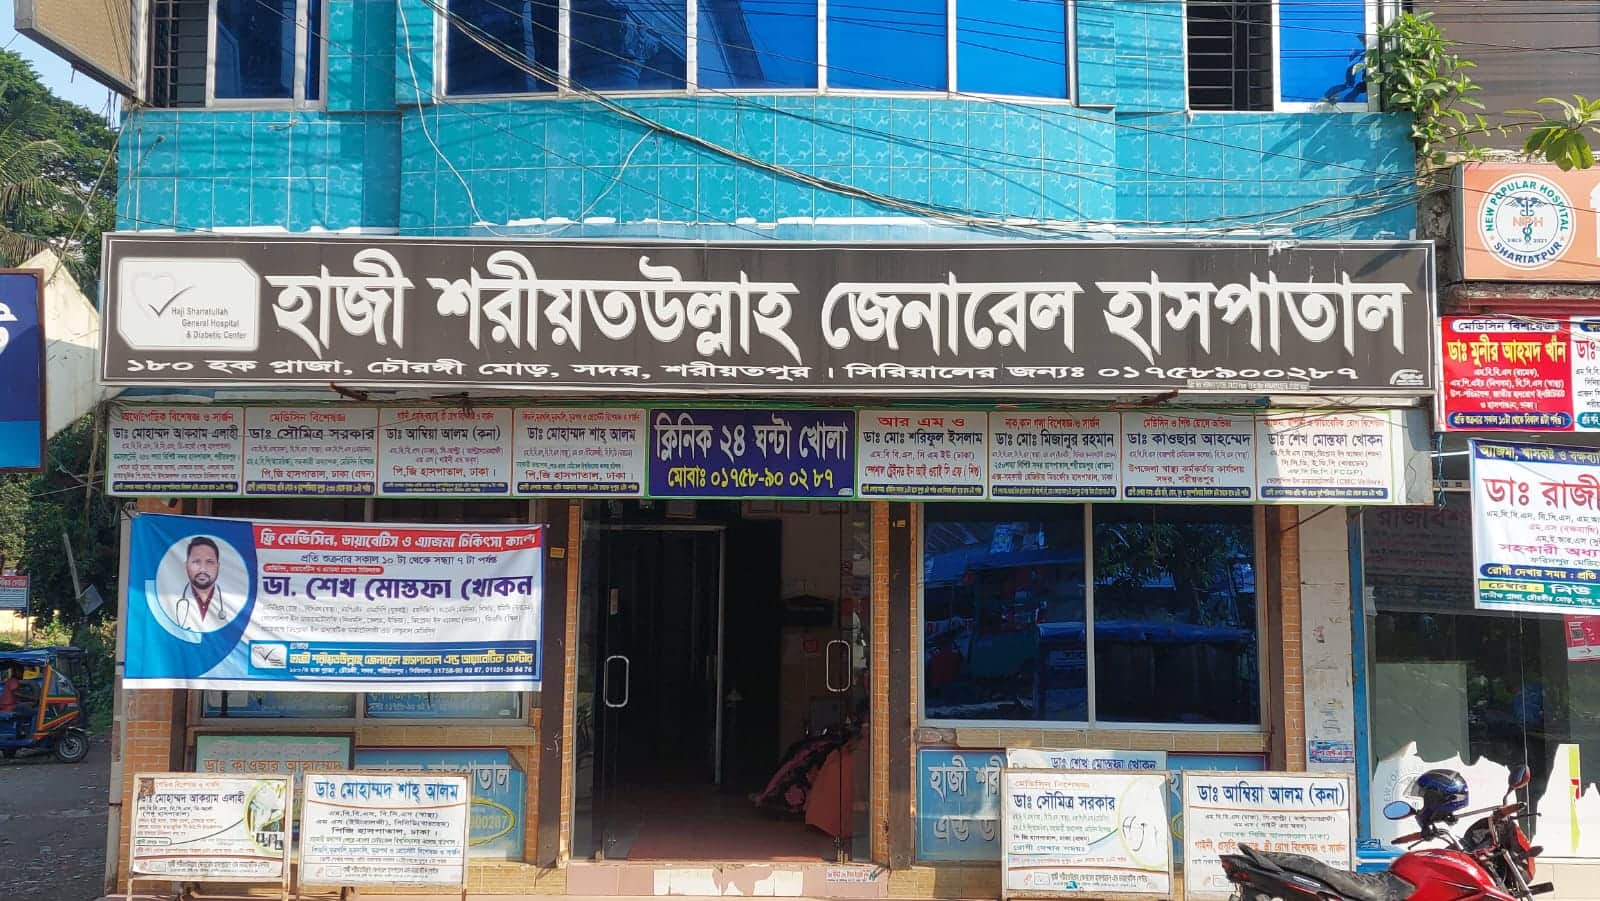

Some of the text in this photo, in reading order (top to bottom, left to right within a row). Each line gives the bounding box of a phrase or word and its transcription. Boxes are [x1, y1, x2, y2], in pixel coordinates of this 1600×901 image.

[1485, 181, 1570, 232] NEW POPULAR HOSPITAL
[1494, 242, 1564, 266] SHARIATPUR
[264, 248, 1413, 366] হাজী শরীয়তউল্লাহ জেনারেল হাসপাতাল
[182, 319, 240, 328] General Hospital
[1446, 339, 1467, 363] ডাঃ
[127, 361, 194, 373] ১৮০
[204, 360, 259, 375] হক
[478, 362, 560, 378] মোড়,
[569, 365, 651, 379] সদর,
[661, 361, 812, 381] শরীয়তপুর
[841, 363, 998, 379] সিরিয়ালের
[1005, 366, 1084, 379] জন্যঃ
[878, 416, 965, 427] আর এম ও
[248, 424, 376, 441] ডাঃ সৌমিত্র সরকার
[384, 427, 402, 441] ডাঃ
[440, 427, 469, 441] আলম
[527, 426, 544, 441] ডাঃ
[609, 427, 636, 442] আলম
[653, 412, 714, 461] ক্লিনিক
[719, 425, 746, 464] ২৪
[798, 420, 849, 462] খোলা
[862, 430, 881, 445] ডাঃ
[884, 430, 905, 445] মোঃ
[947, 429, 983, 447] ইসলাম
[994, 428, 1114, 450] ডাঃ মোঃ মিজানুর রহমান
[1126, 432, 1148, 446] ডাঃ
[1151, 432, 1197, 447] কাওছার
[1288, 432, 1308, 446] শেখ
[1351, 432, 1384, 447] খোকন
[1482, 473, 1530, 507] ডাঃ
[278, 529, 338, 550] মেডিসিন,
[402, 536, 412, 547] ও
[1498, 544, 1560, 555] সহকারী
[354, 554, 380, 565] সকাল
[306, 577, 357, 601] শেখ
[364, 578, 452, 602] মোস্তফা
[460, 575, 534, 601] খোকন
[928, 755, 970, 804] হাজী
[314, 780, 336, 799] ডাঃ
[340, 780, 394, 801] মোহাম্মদ
[424, 781, 460, 802] আলম
[1013, 790, 1116, 811] ডাঃ সৌমিত্র সরকার
[1196, 784, 1218, 803] ডাঃ
[1268, 783, 1304, 804] আলম
[1309, 782, 1345, 806] (কনা)
